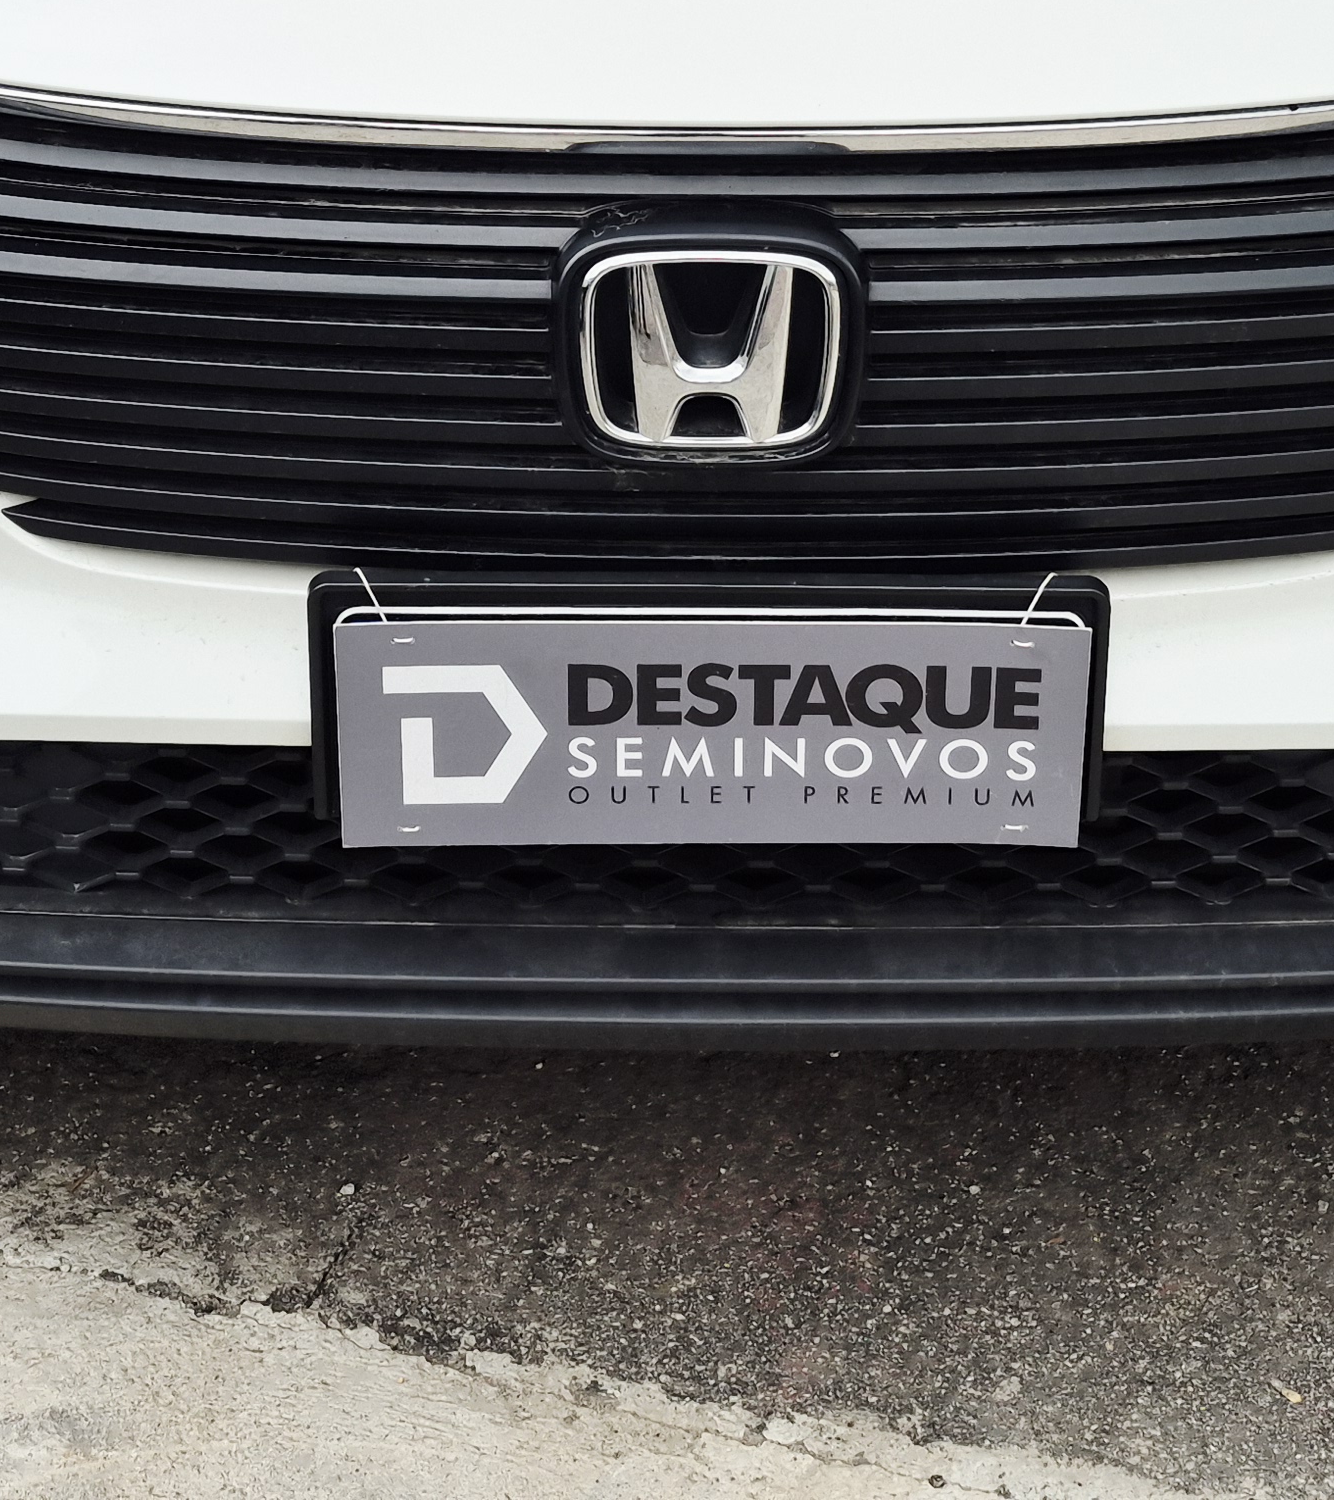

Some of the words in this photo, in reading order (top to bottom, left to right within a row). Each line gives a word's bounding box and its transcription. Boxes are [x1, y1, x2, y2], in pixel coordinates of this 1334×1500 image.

[567, 662, 1042, 734] DESTAQUE
[567, 736, 1038, 782] SEMINOVOS
[568, 785, 756, 805] OUTLET
[803, 785, 1036, 808] PREMIUM
